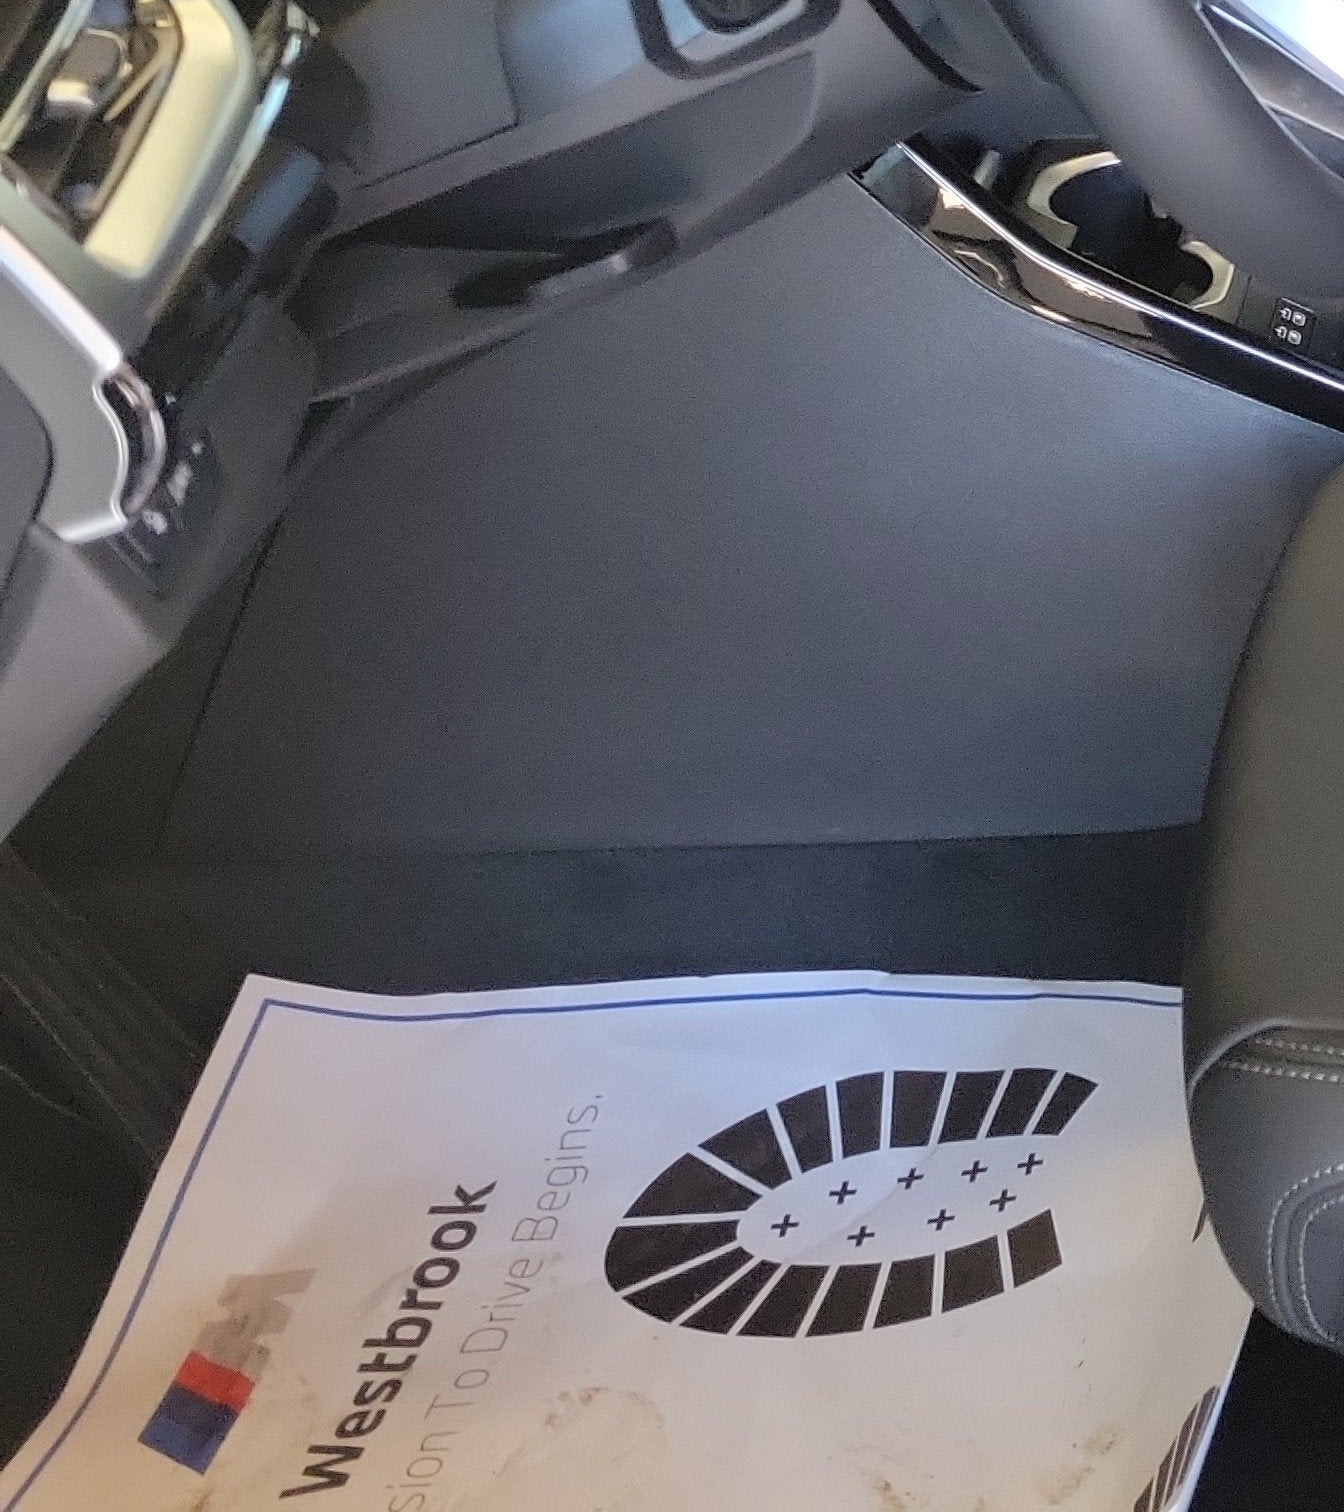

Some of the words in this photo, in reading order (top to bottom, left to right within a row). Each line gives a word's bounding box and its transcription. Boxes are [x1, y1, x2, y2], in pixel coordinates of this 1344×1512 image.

[278, 1180, 498, 1500] Westbrook
[424, 1367, 491, 1420] To
[459, 1256, 545, 1356] Drive
[511, 1093, 603, 1243] Begins.
